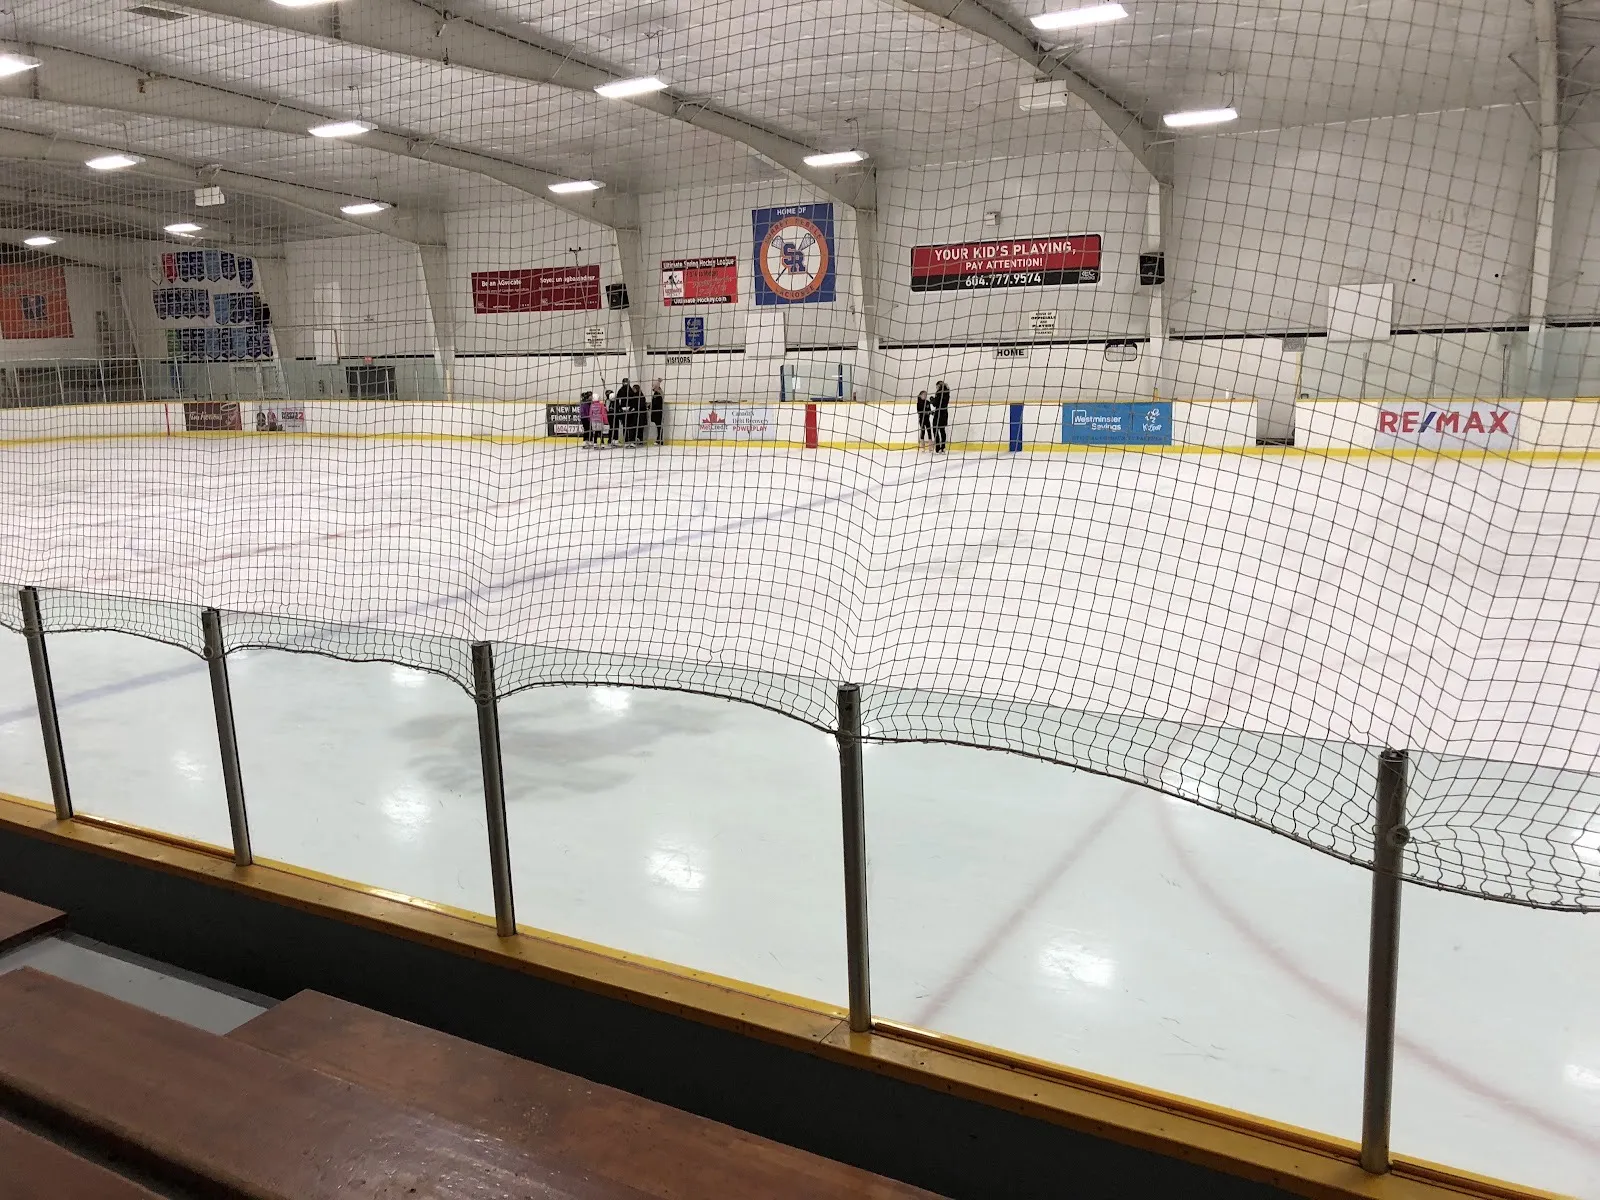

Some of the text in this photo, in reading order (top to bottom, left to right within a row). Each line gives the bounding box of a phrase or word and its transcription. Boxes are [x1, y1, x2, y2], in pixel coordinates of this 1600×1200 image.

[935, 241, 1076, 261] YOUR KID'S PLAYING,
[965, 258, 1043, 271] PAY ATTENTION!
[965, 273, 1041, 287] 604.777.9574
[666, 356, 691, 364] VISITORS
[1091, 423, 1121, 432] Savings
[1379, 411, 1509, 433] RE/MAX
